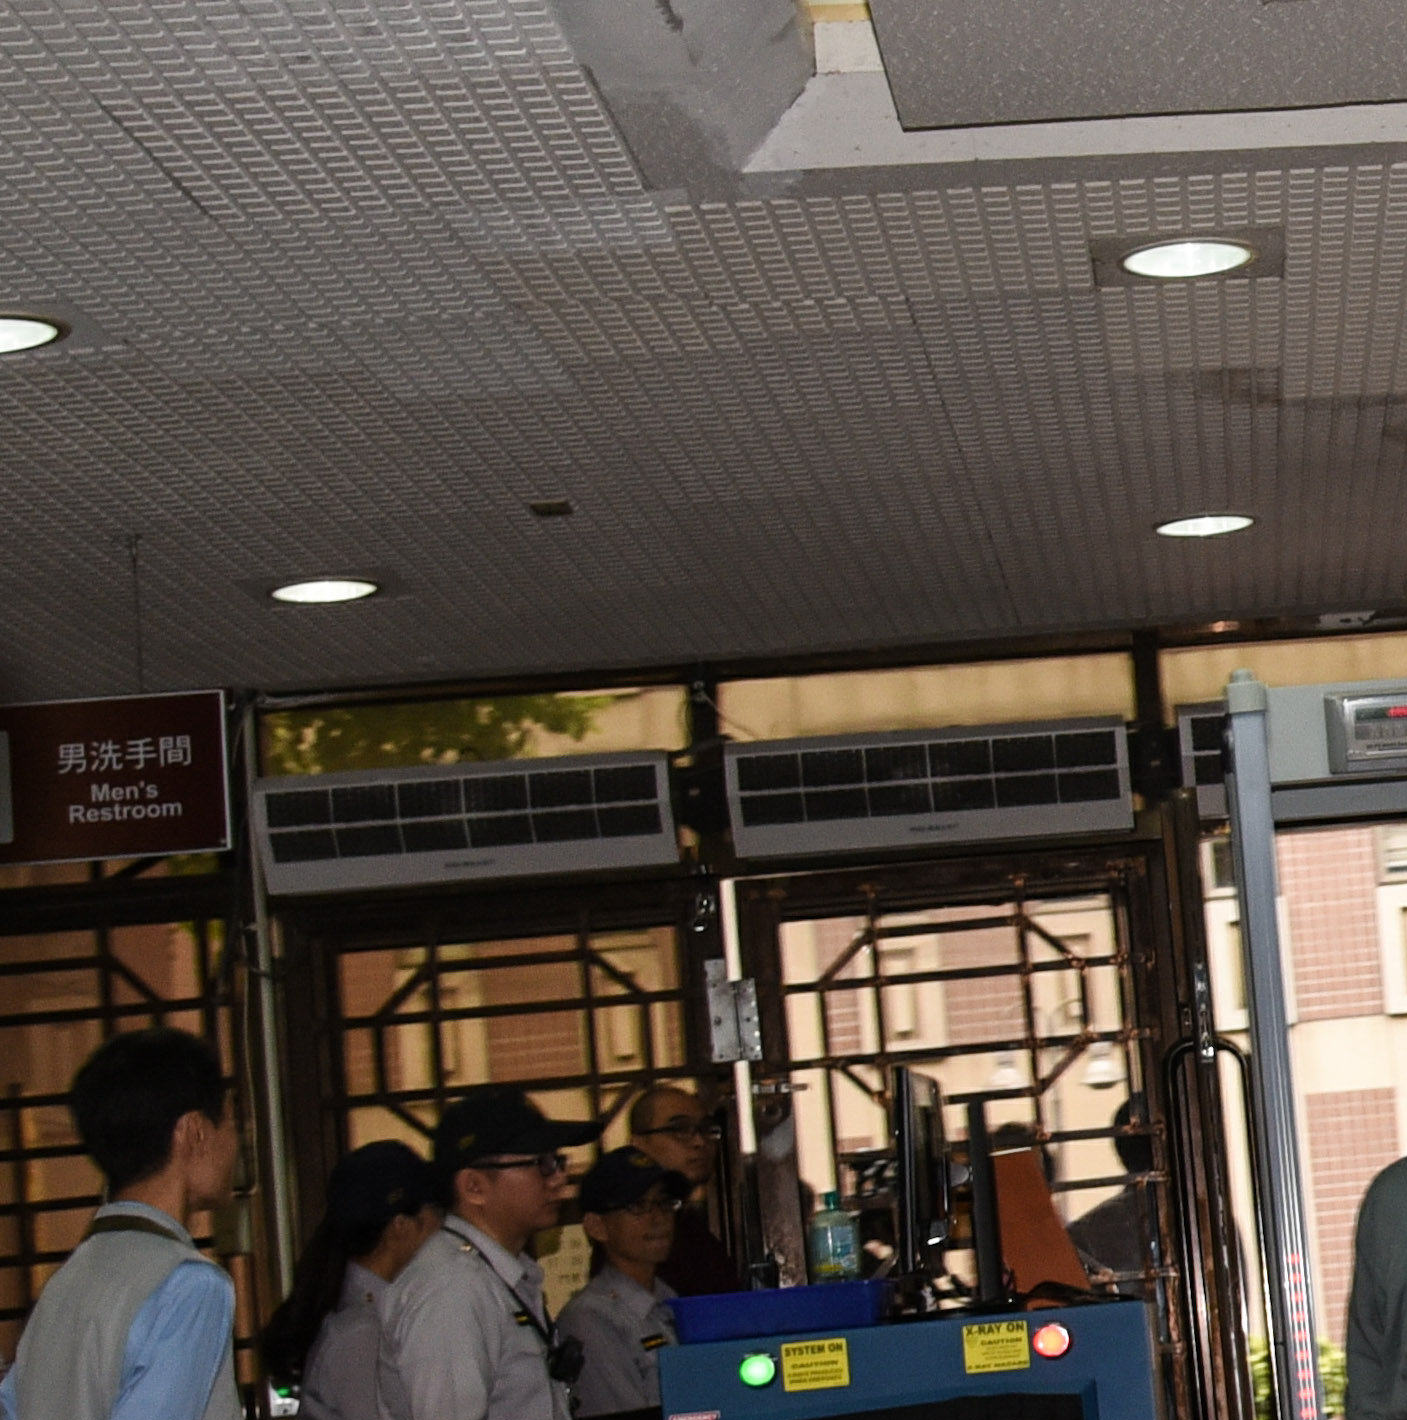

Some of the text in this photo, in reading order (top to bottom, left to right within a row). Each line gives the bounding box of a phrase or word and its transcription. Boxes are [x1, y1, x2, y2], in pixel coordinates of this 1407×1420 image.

[57, 734, 194, 774] 男洗手間
[90, 781, 160, 803] Men's
[68, 802, 183, 825] Restroom
[966, 1322, 1024, 1337] X-RAY ON
[784, 1342, 843, 1358] SYSTEM ON
